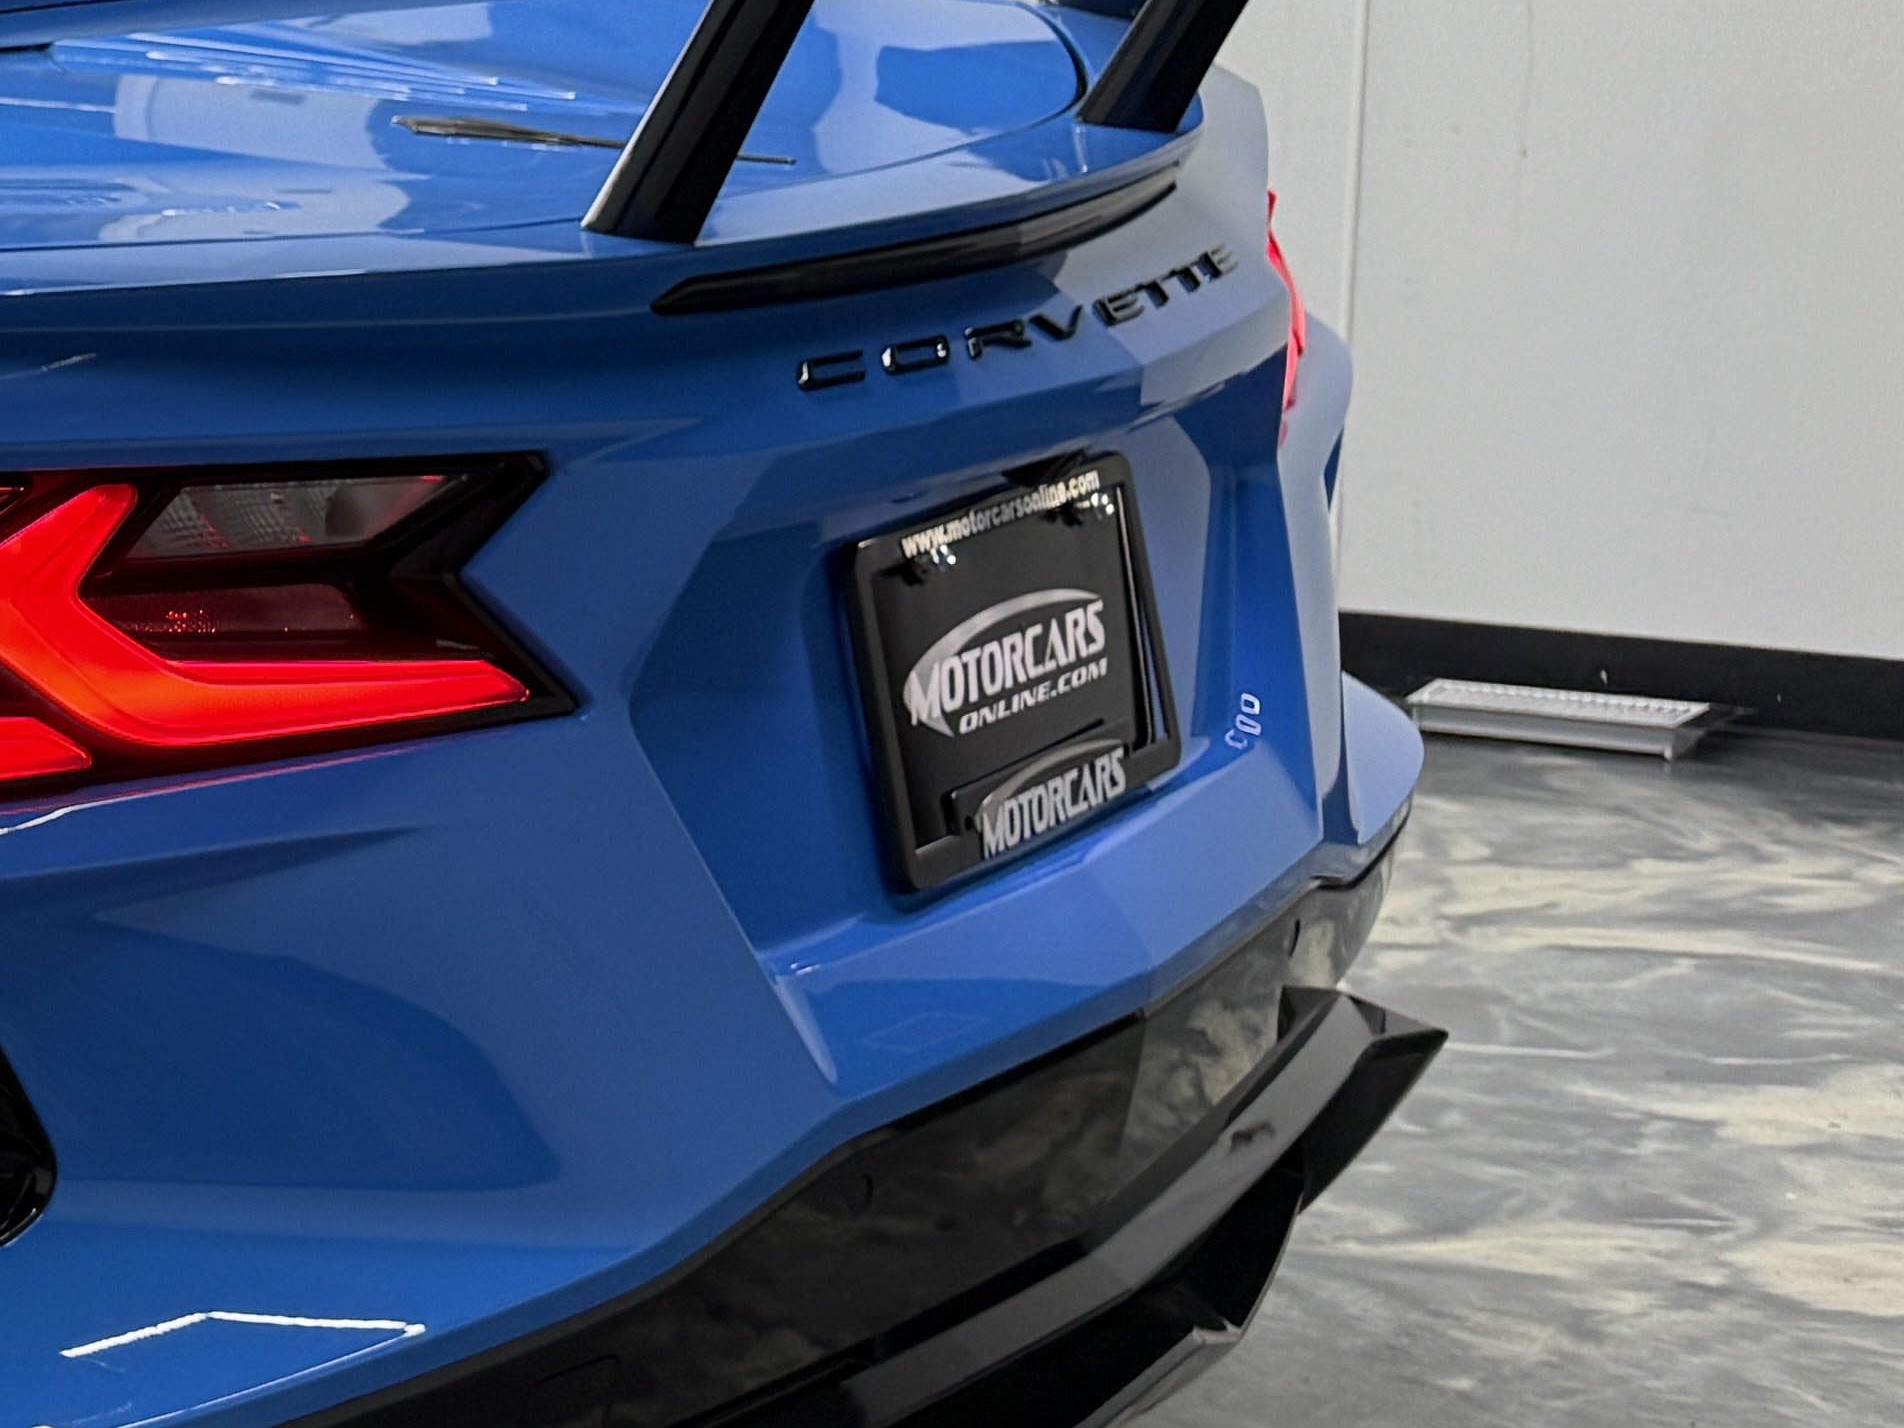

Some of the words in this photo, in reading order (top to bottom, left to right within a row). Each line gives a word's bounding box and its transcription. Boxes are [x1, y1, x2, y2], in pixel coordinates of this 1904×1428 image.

[797, 243, 1239, 391] CORVETTE
[902, 470, 1100, 557] www.motorcarsonline.com
[910, 601, 1106, 724] MOTORCARS
[959, 656, 1108, 733] ONLINE.COM
[981, 749, 1126, 859] MOTORCARS
